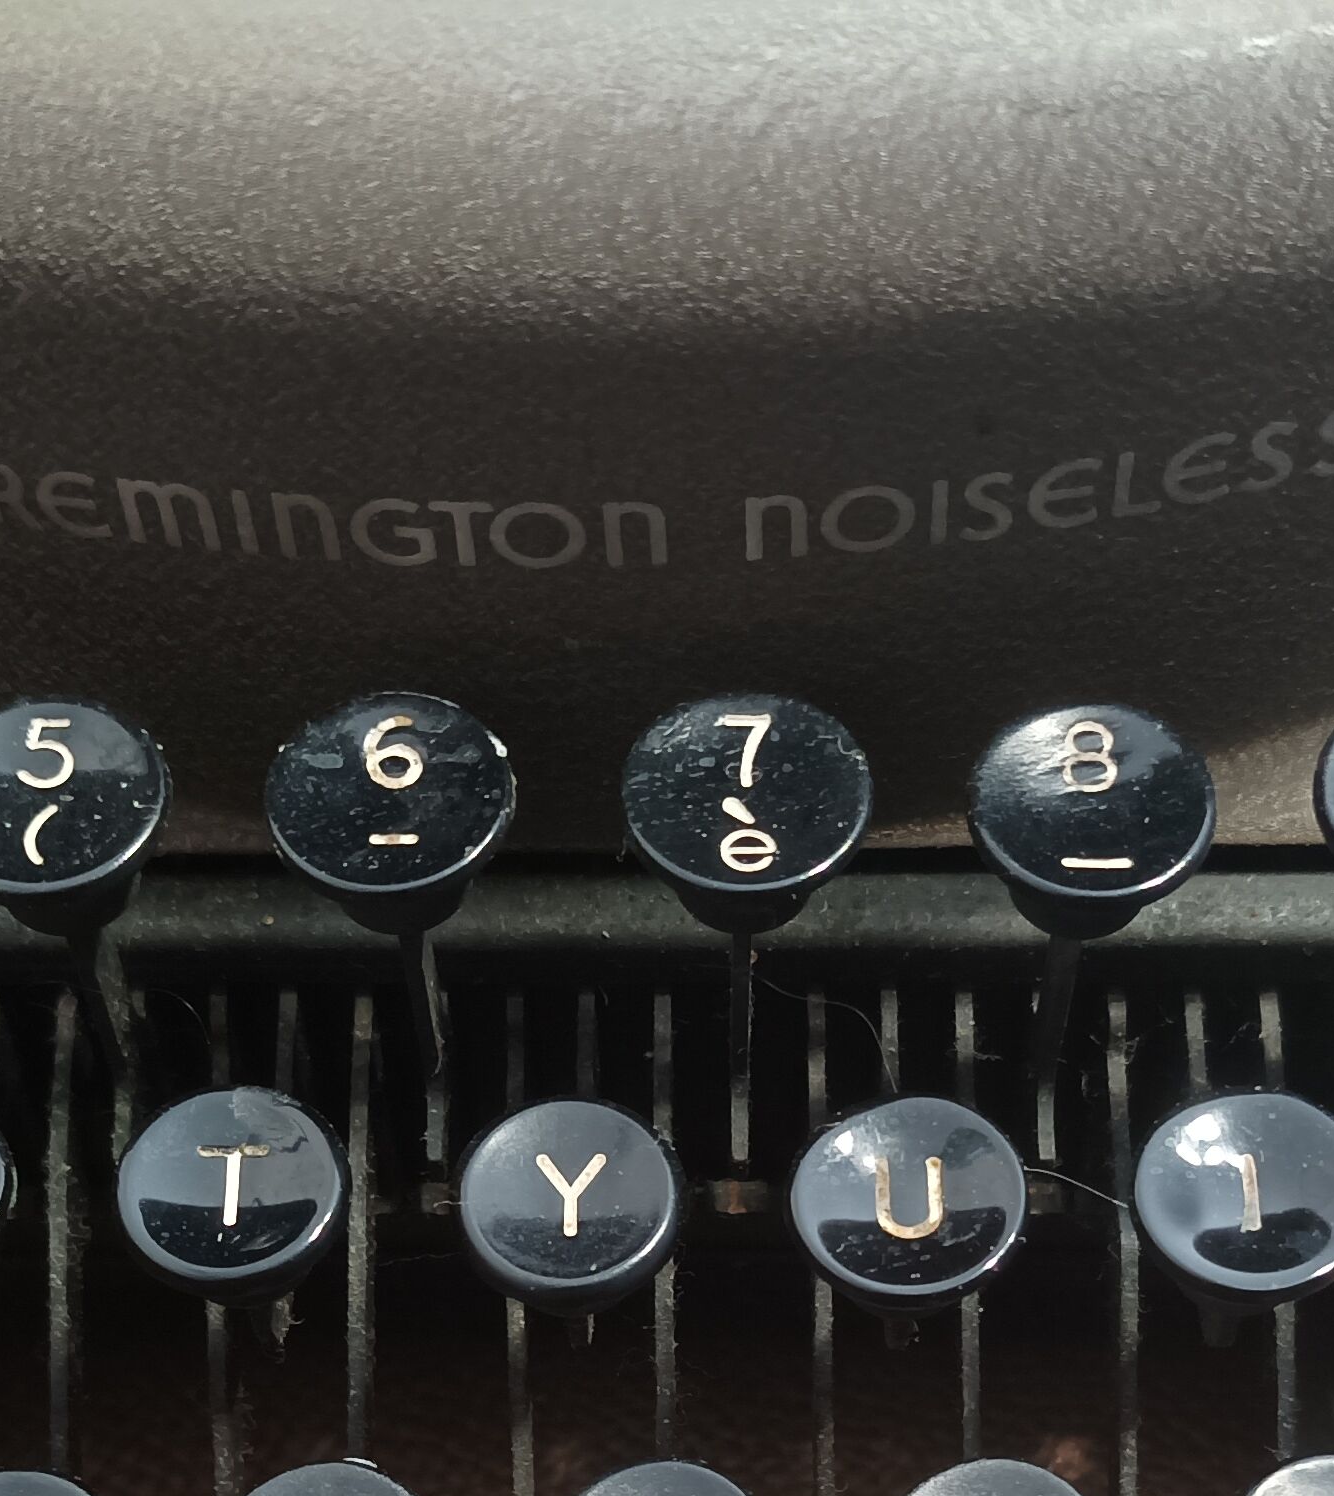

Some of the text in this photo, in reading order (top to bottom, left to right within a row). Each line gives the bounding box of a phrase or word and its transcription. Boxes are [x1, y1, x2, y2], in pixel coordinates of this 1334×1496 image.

[15, 717, 75, 790] 5
[363, 715, 423, 790] 6
[716, 713, 773, 788] 7
[1062, 720, 1120, 793] 8
[719, 796, 778, 873] è
[197, 1143, 268, 1226] T
[535, 1152, 608, 1237] Y
[874, 1155, 946, 1240] U
